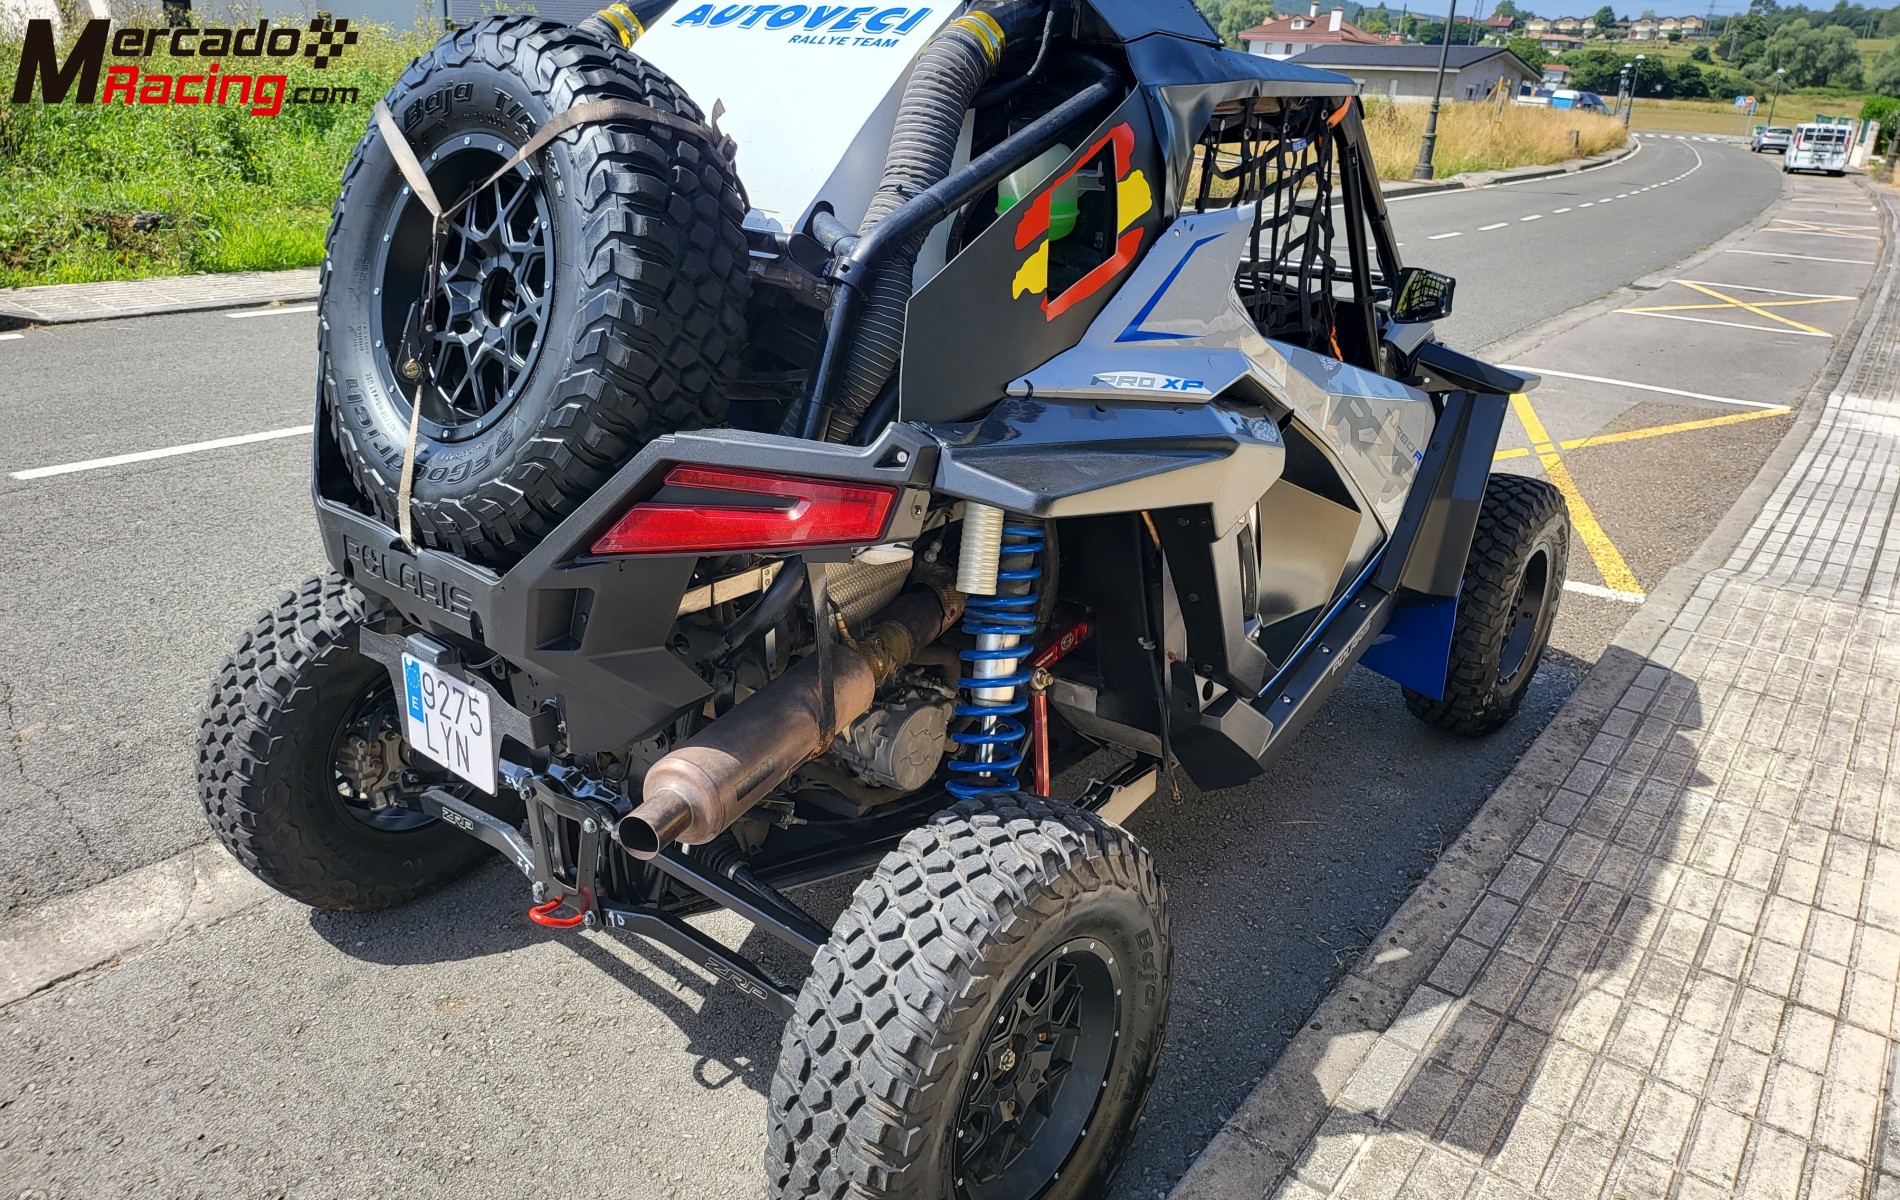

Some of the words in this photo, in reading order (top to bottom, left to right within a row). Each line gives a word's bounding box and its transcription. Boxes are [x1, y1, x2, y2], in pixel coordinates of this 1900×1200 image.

[672, 4, 933, 35] AUTOVECI
[788, 35, 850, 46] RALLYE
[852, 37, 900, 48] TEAM
[404, 80, 474, 134] Baja
[364, 372, 374, 385] USE
[1090, 375, 1156, 389] PRO
[1160, 378, 1204, 390] XP
[343, 534, 473, 621] POLARIS
[411, 694, 420, 712] E
[422, 672, 483, 737] 9275
[425, 713, 470, 773] LYN
[704, 956, 768, 1000] ZRP
[1135, 928, 1159, 1007] Baja
